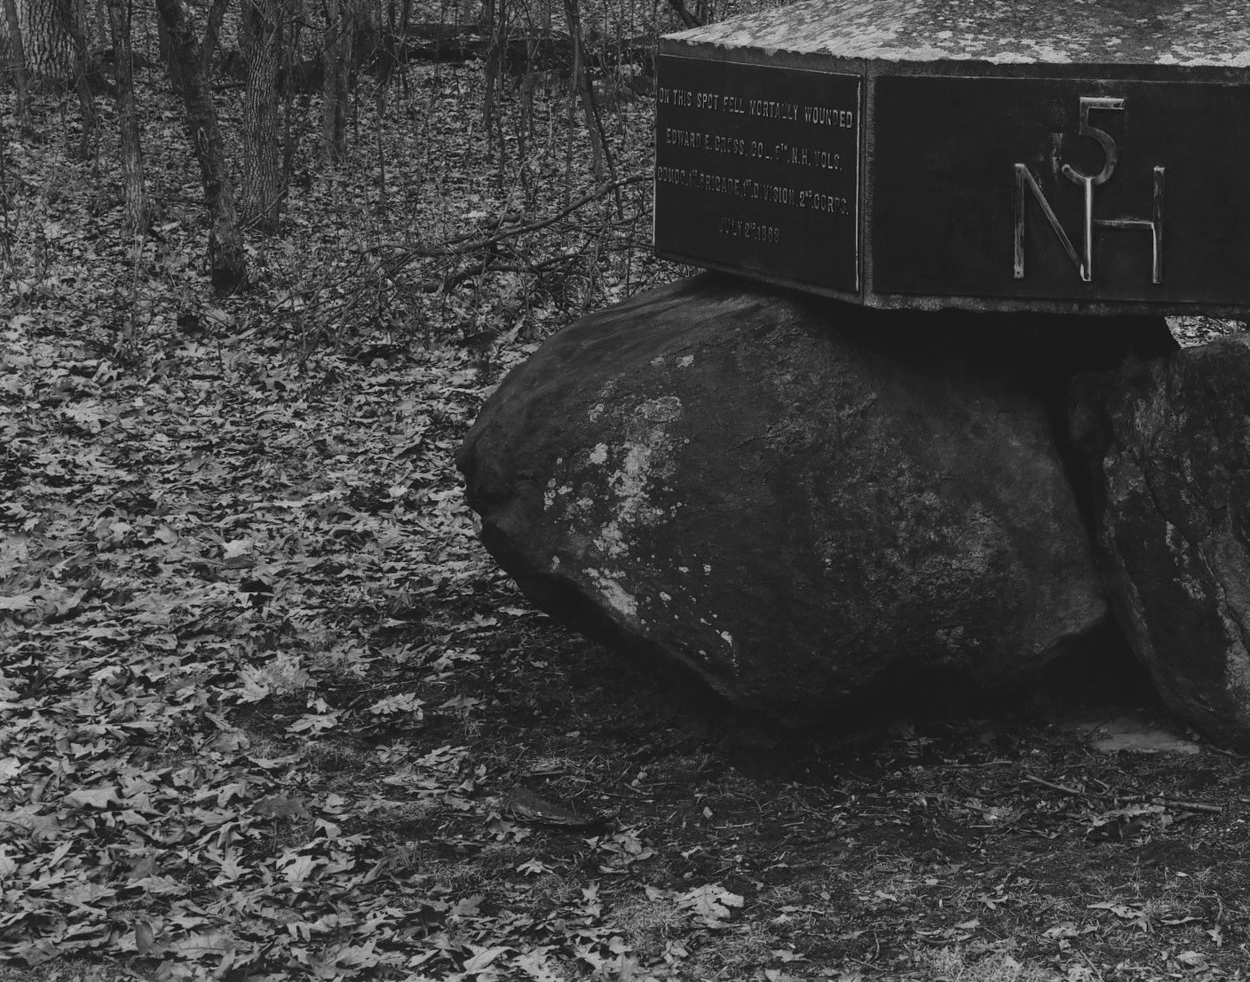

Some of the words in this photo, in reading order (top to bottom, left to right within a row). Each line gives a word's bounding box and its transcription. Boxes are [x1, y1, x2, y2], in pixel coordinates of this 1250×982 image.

[658, 87, 671, 104] ON
[673, 89, 692, 107] THIS
[697, 91, 719, 111] SPOT
[722, 95, 745, 114] FELL
[749, 99, 799, 121] MORTALLY
[804, 106, 853, 129] WOUNDED
[666, 127, 701, 149] EDWARD
[704, 133, 713, 150] E.
[1061, 96, 1126, 187] 5
